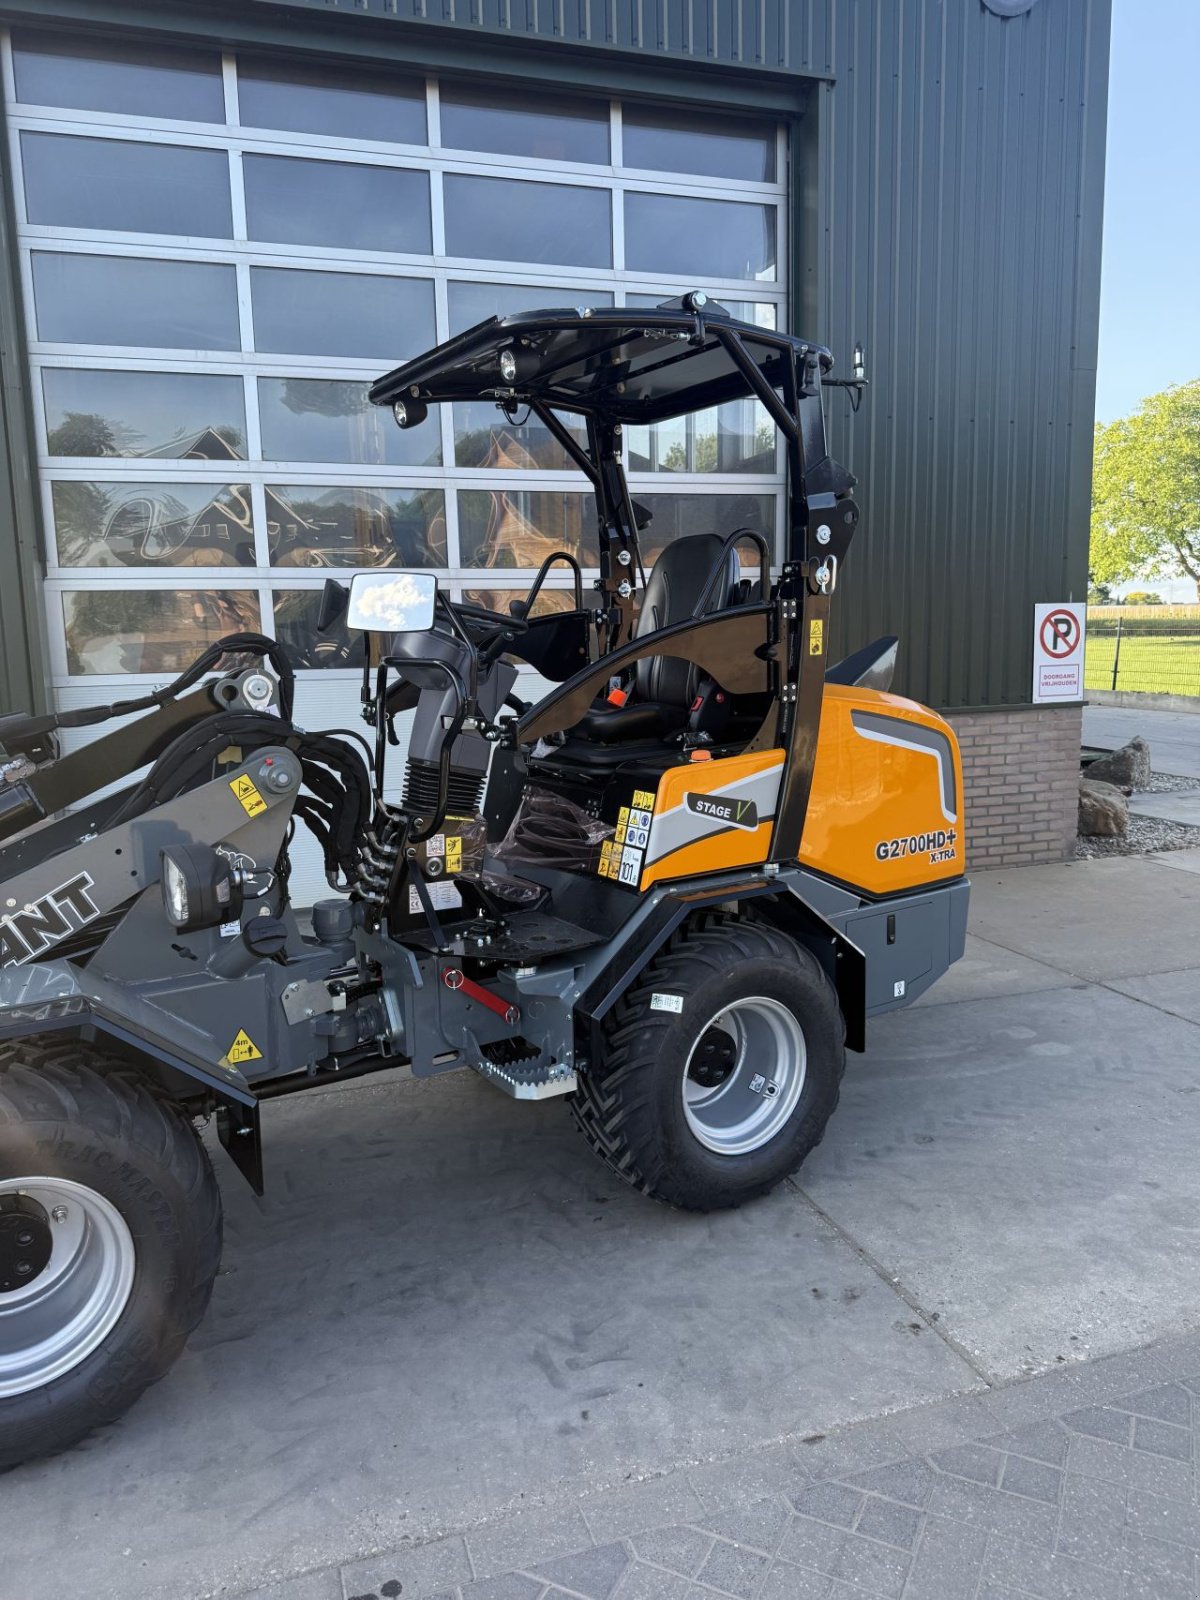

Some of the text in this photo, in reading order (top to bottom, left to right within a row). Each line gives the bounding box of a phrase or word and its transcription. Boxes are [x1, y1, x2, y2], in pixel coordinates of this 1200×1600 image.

[696, 798, 753, 821] STAGE V
[876, 828, 957, 861] G2700HD+
[929, 848, 956, 864] X-TRA
[621, 861, 634, 882] 101
